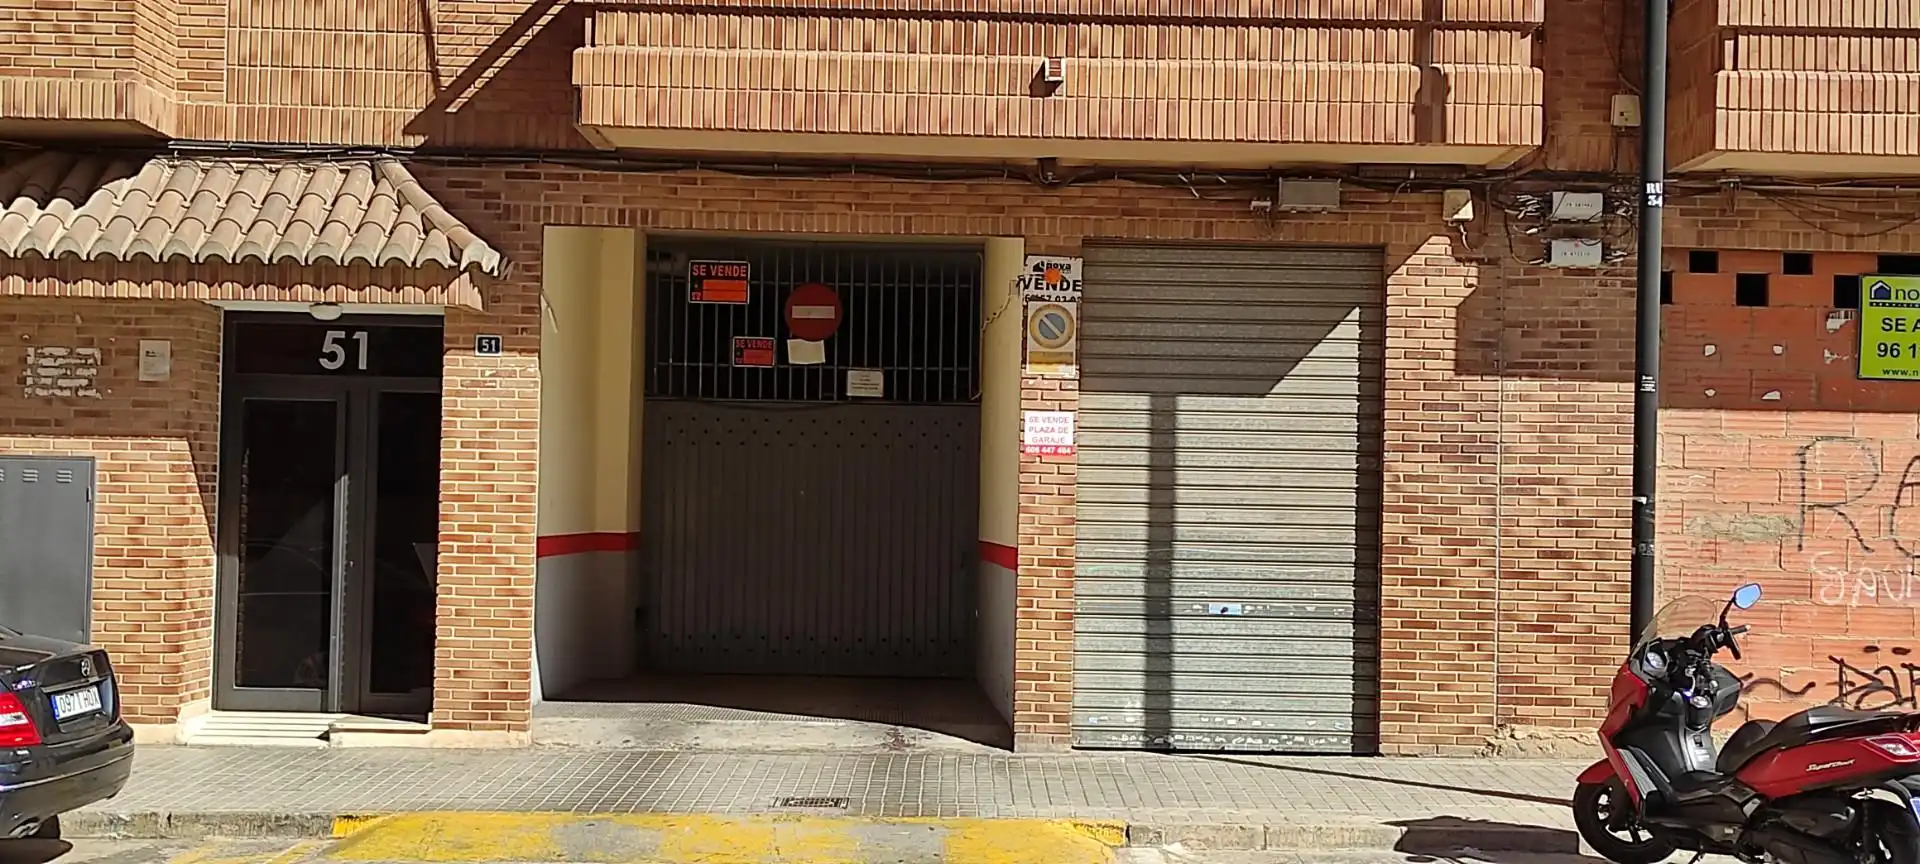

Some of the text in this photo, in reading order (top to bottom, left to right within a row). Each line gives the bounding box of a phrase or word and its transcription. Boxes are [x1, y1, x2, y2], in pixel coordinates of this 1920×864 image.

[692, 264, 747, 277] SE VENDE
[1023, 276, 1082, 292] VENDE
[1881, 317, 1907, 333] SE
[318, 330, 369, 370] 51
[481, 339, 497, 352] 51
[735, 339, 773, 349] SE VENDE
[1877, 342, 1901, 358] 96
[1028, 416, 1070, 424] SE VENDE
[1028, 426, 1056, 434] PLAZA
[1031, 436, 1065, 444] GARAJE
